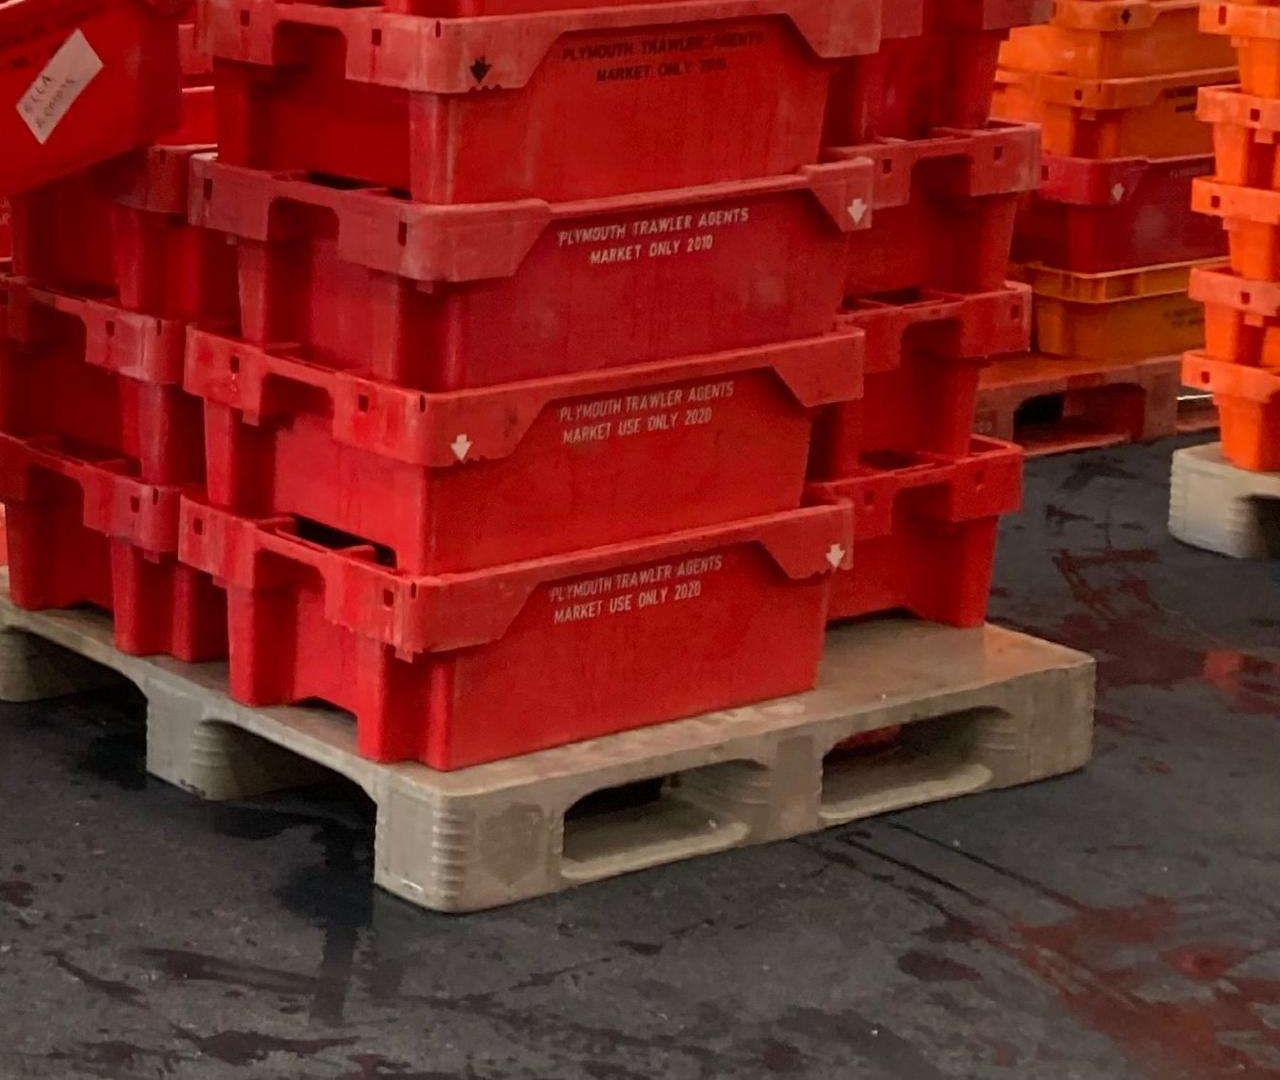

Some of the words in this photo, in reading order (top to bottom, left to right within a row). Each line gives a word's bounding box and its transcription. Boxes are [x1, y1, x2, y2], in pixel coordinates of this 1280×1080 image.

[562, 42, 633, 61] PLYMOUTH
[642, 36, 705, 55] TRAWLER
[596, 64, 652, 82] MARKET
[558, 224, 626, 247] PLYMOUTH
[632, 215, 693, 237] TRAWLER
[697, 207, 750, 229] AGENTS
[590, 244, 642, 265] MARKET
[648, 240, 681, 258] ONLY
[686, 234, 714, 252] 2010
[560, 398, 622, 422] PLYMOUTH
[625, 389, 684, 413] TRAWLER
[688, 381, 735, 402] AGENTS
[562, 422, 612, 444] MARKET
[617, 418, 641, 436] USE
[647, 412, 680, 433] ONLY
[684, 407, 713, 426] 2020
[550, 577, 612, 603] PLYMOUTH
[616, 565, 672, 589] TRAWLER
[676, 554, 723, 577] AGENTS
[554, 601, 602, 625] MARKET
[609, 594, 633, 613] USE
[638, 587, 669, 608] ONLY
[674, 580, 701, 601] 2020
